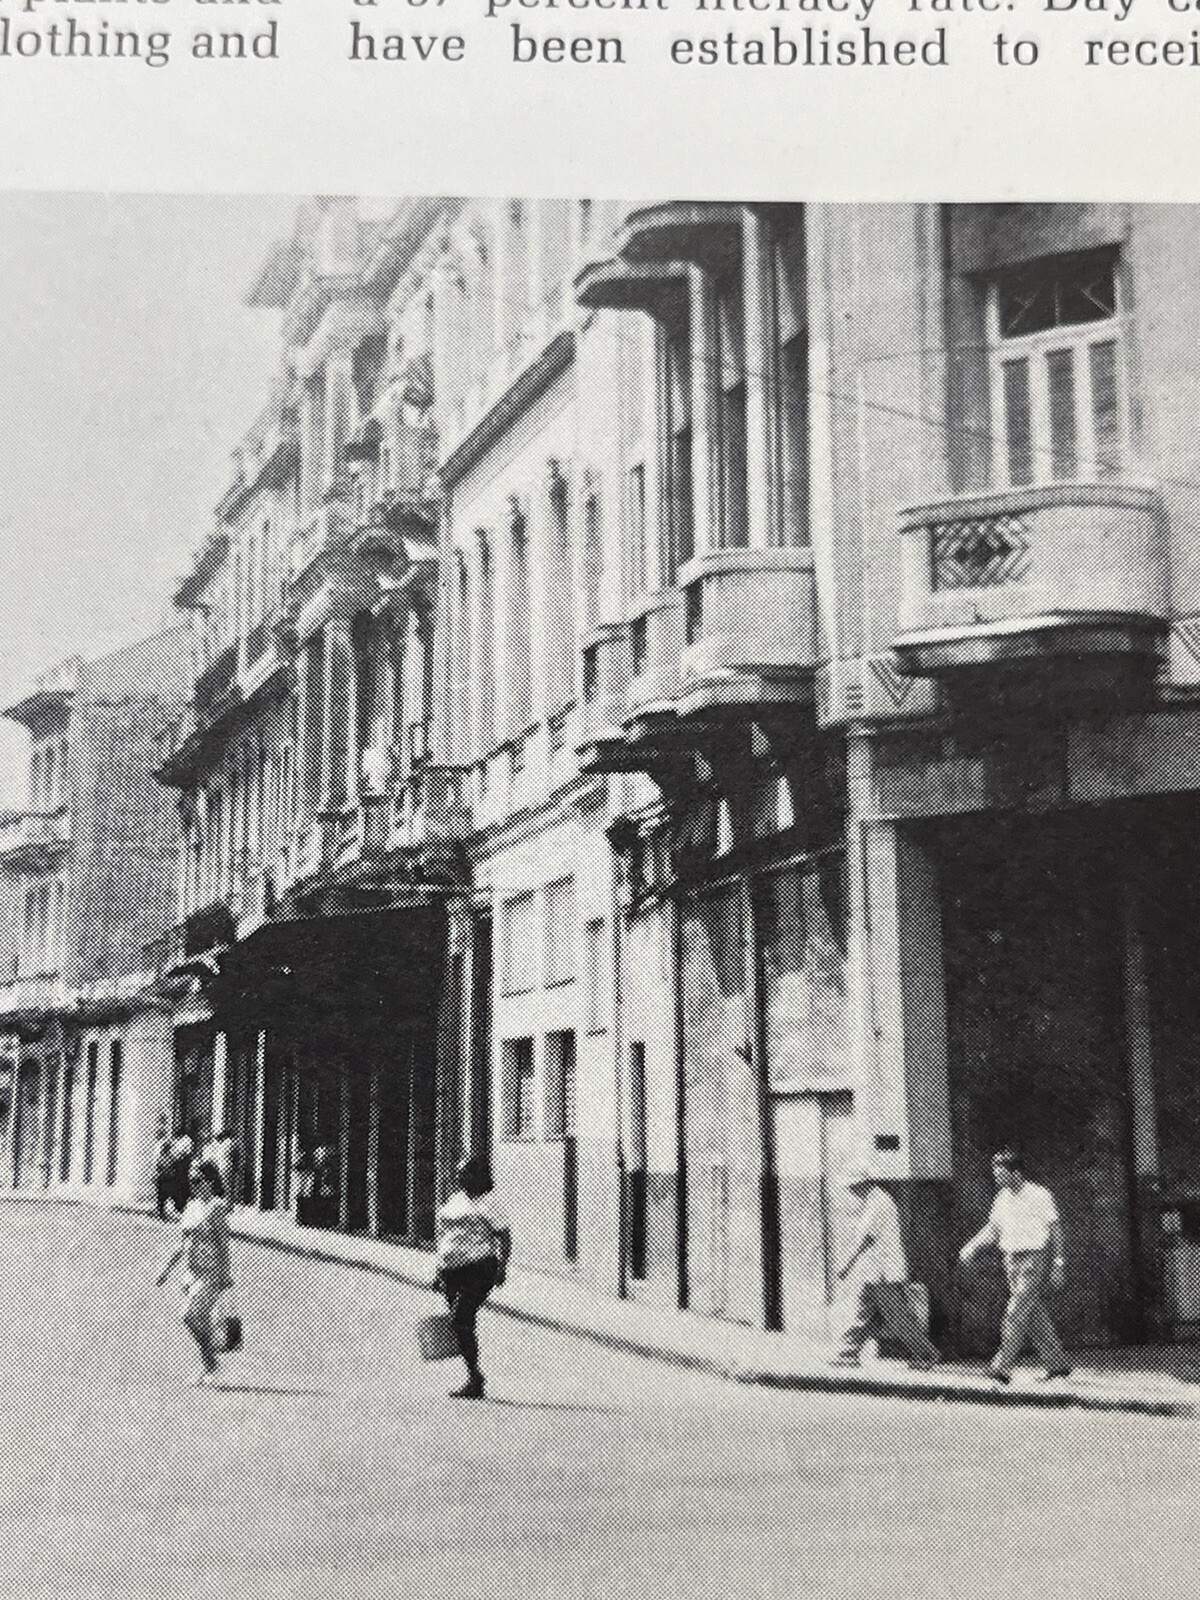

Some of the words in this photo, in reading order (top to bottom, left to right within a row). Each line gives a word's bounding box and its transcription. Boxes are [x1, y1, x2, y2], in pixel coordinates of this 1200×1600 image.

[0, 18, 172, 67] lothing
[191, 20, 280, 59] and
[348, 21, 466, 61] have
[510, 23, 626, 63] been
[670, 26, 950, 66] established
[993, 32, 1040, 66] to
[1084, 30, 1200, 66] recei
